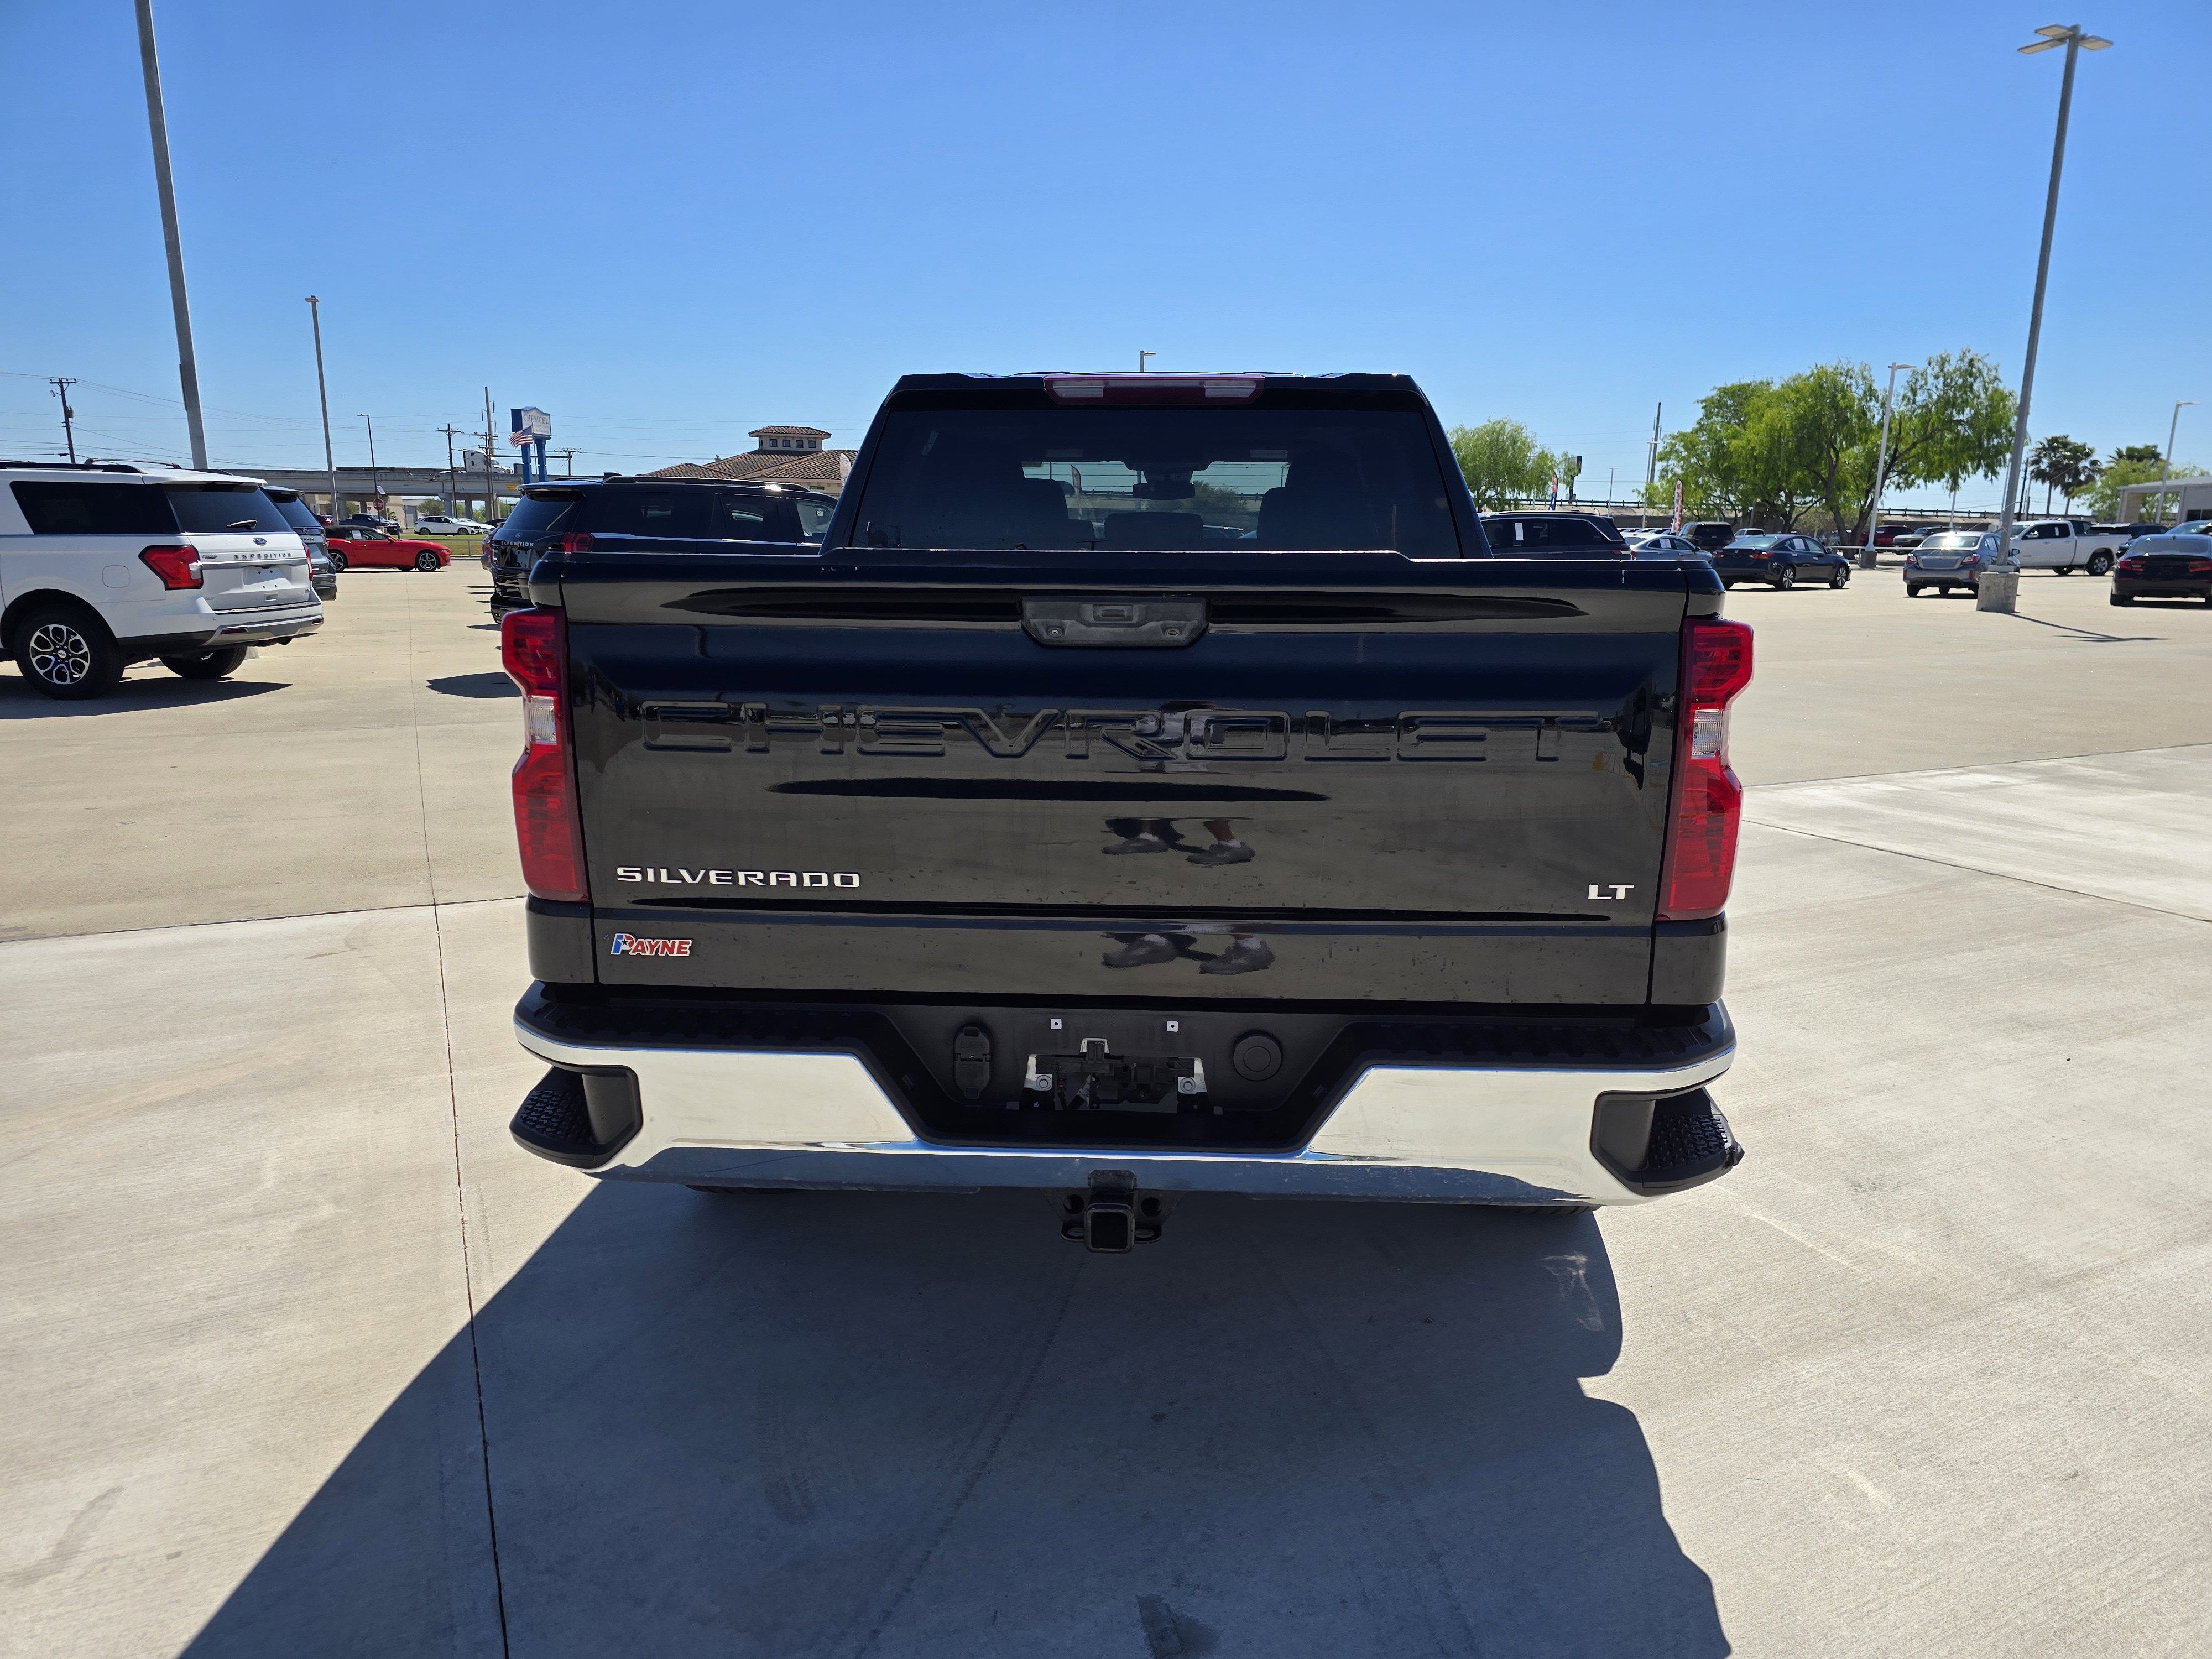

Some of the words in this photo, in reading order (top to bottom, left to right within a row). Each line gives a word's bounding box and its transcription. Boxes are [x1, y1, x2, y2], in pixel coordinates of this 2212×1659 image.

[523, 414, 549, 424] CHEMCEL
[640, 700, 1601, 763] CHEVROLET
[615, 866, 861, 888] SILVERADO
[1588, 884, 1635, 900] LT
[611, 933, 693, 957] PAYNE
